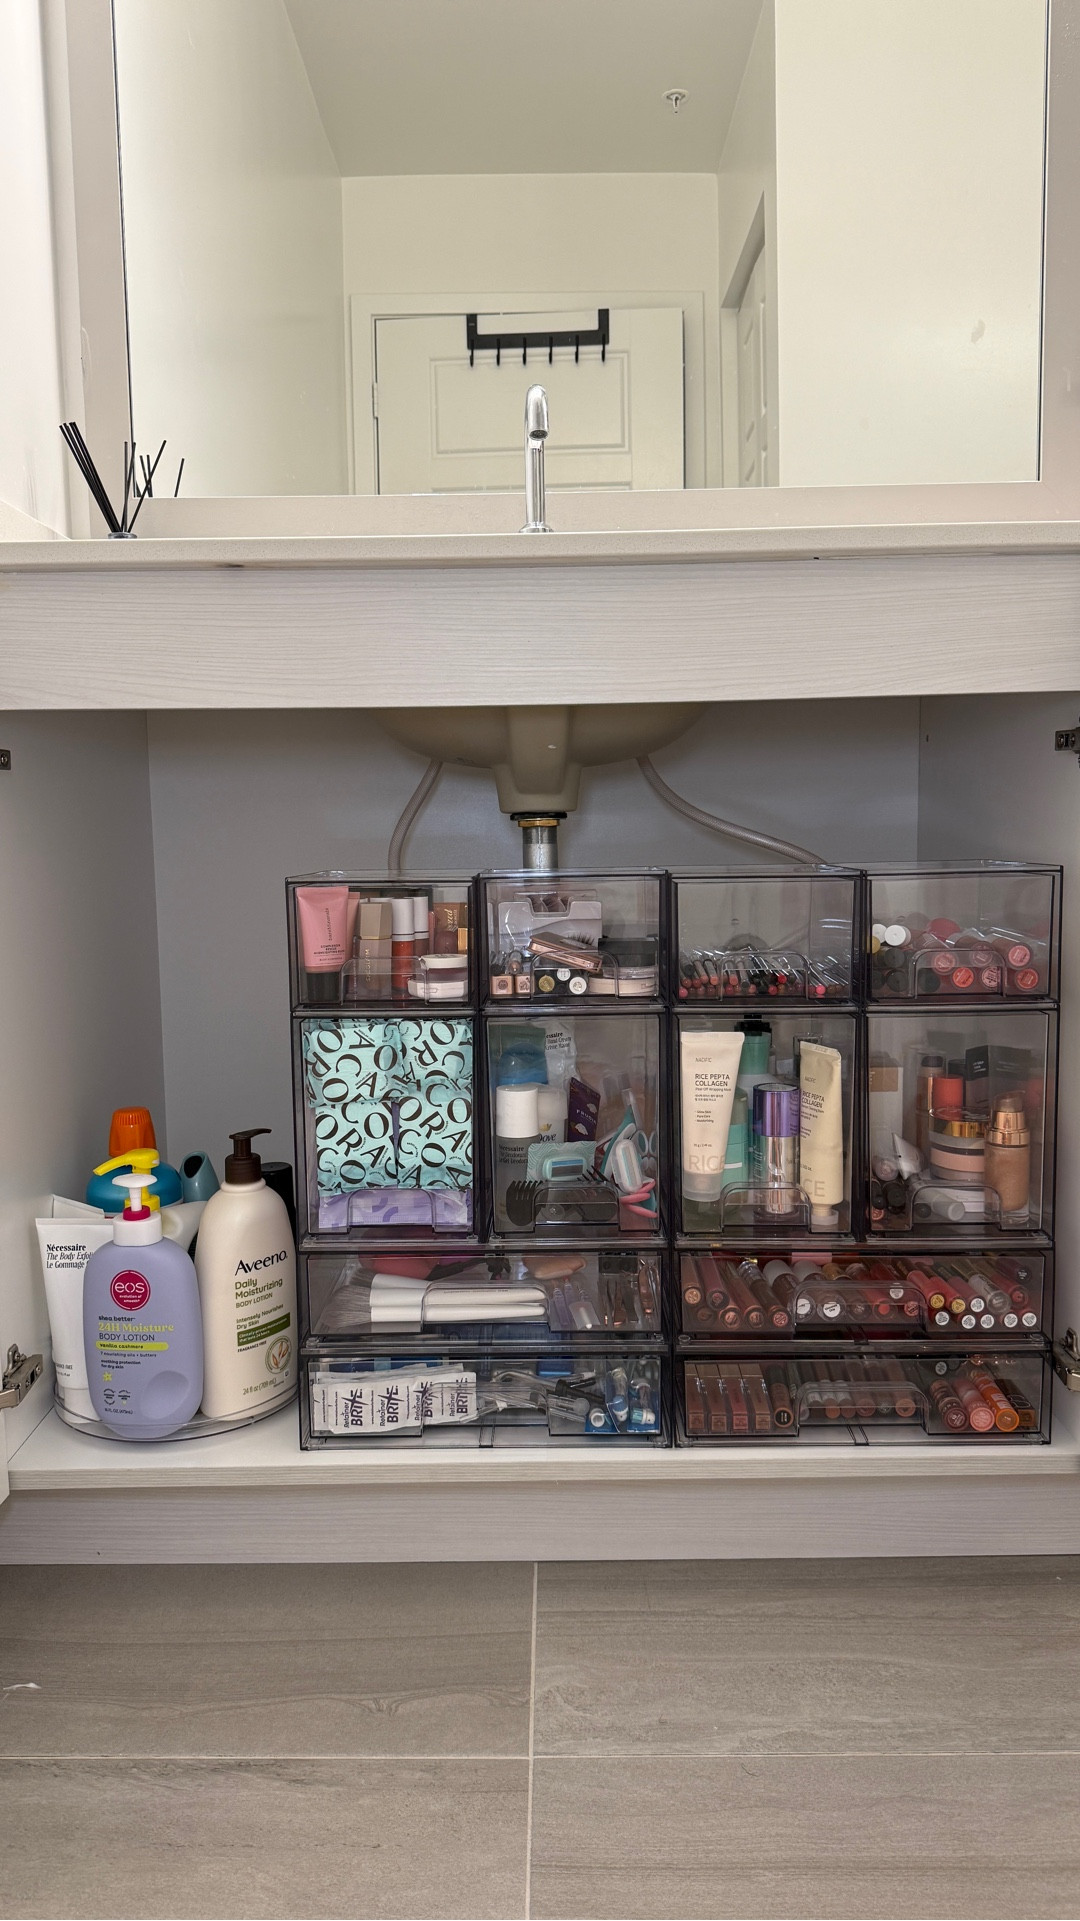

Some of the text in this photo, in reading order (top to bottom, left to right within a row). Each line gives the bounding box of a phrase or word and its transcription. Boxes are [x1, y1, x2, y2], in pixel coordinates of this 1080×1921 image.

[46, 1243, 86, 1252] Nécessaire
[60, 1252, 75, 1261] Body
[55, 1261, 85, 1269] Gommage
[114, 1282, 145, 1293] eos
[235, 1279, 258, 1290] Daily
[235, 1279, 283, 1299] Moisturizing
[236, 1292, 273, 1309] BODY LOTION
[98, 1322, 174, 1333] 24H Moisture
